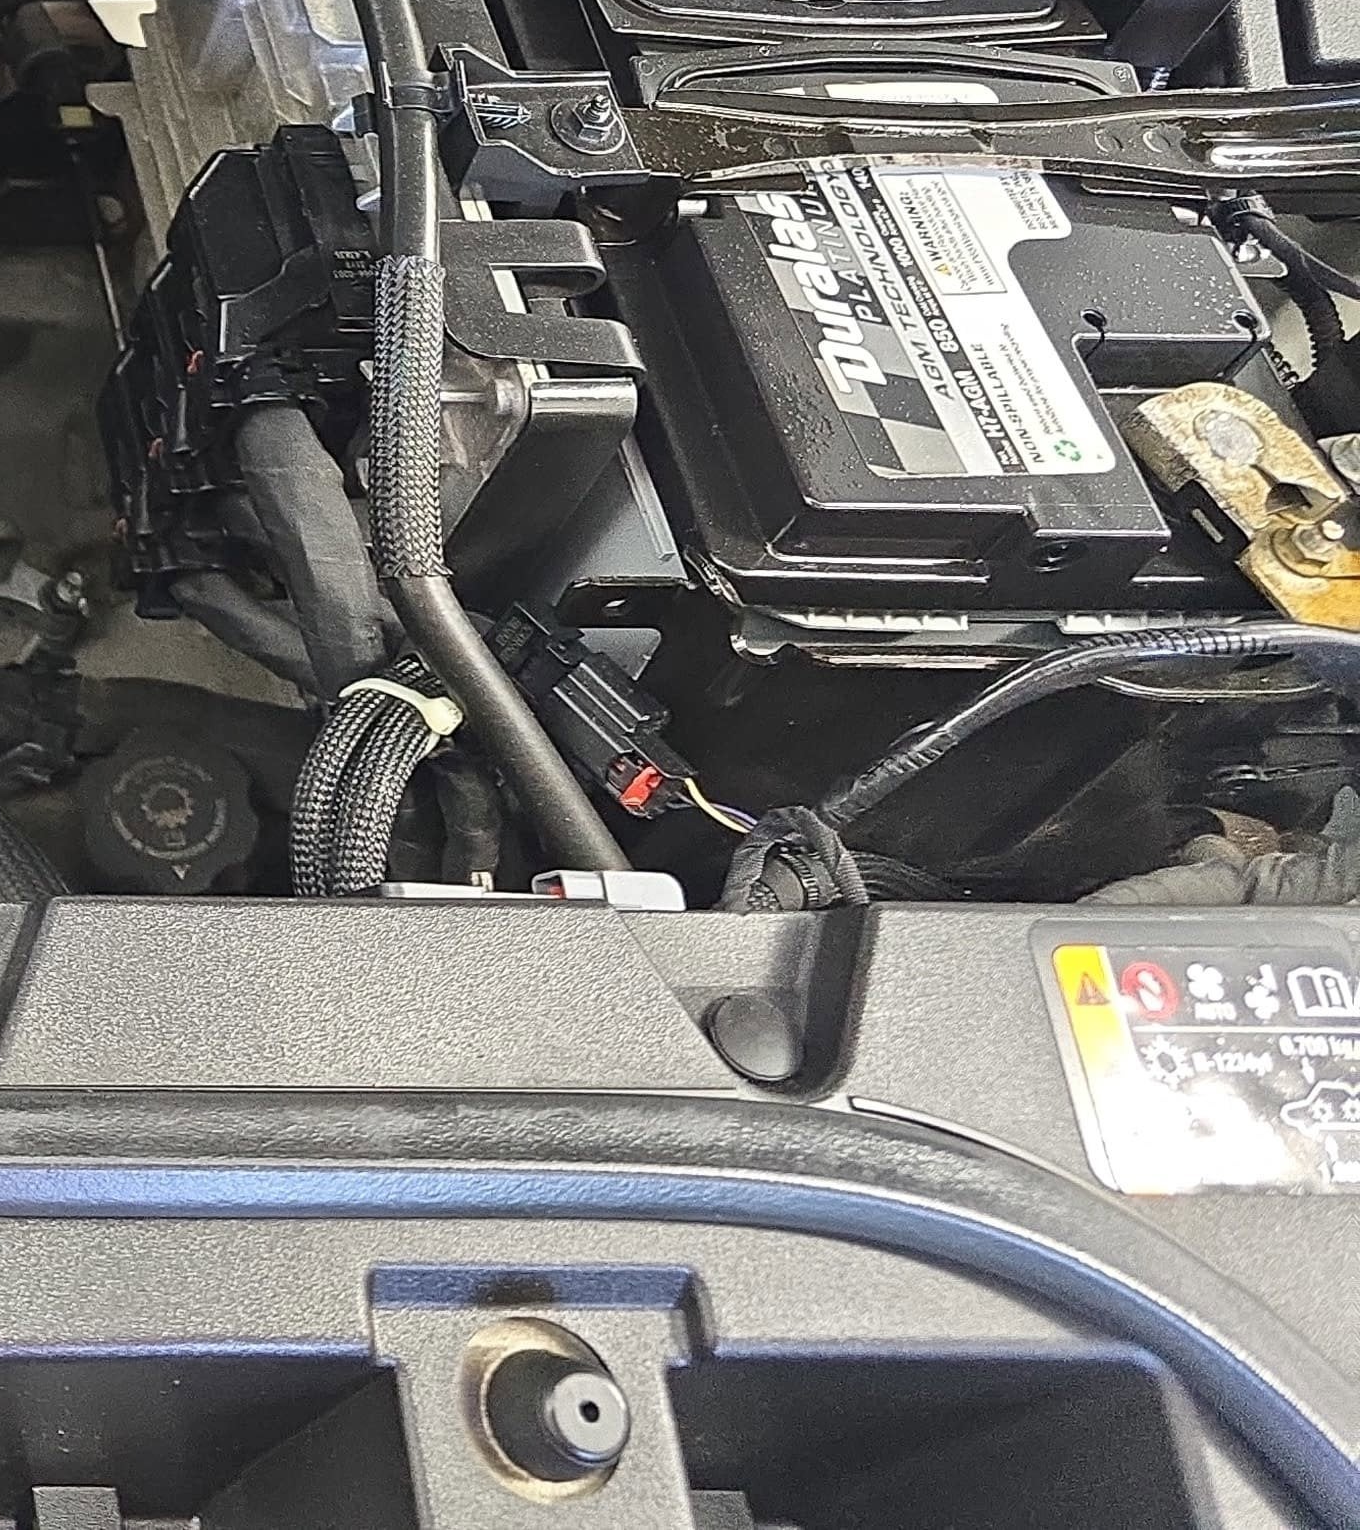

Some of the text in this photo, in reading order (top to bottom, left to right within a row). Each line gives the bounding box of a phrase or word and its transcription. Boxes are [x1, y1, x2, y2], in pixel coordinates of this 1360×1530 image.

[886, 237, 915, 266] 1000
[897, 191, 943, 261] WARNING:
[754, 191, 888, 393] Duralas
[926, 318, 960, 351] 850
[909, 340, 954, 399] AGM
[971, 342, 1045, 462] NON-SPILLABLE
